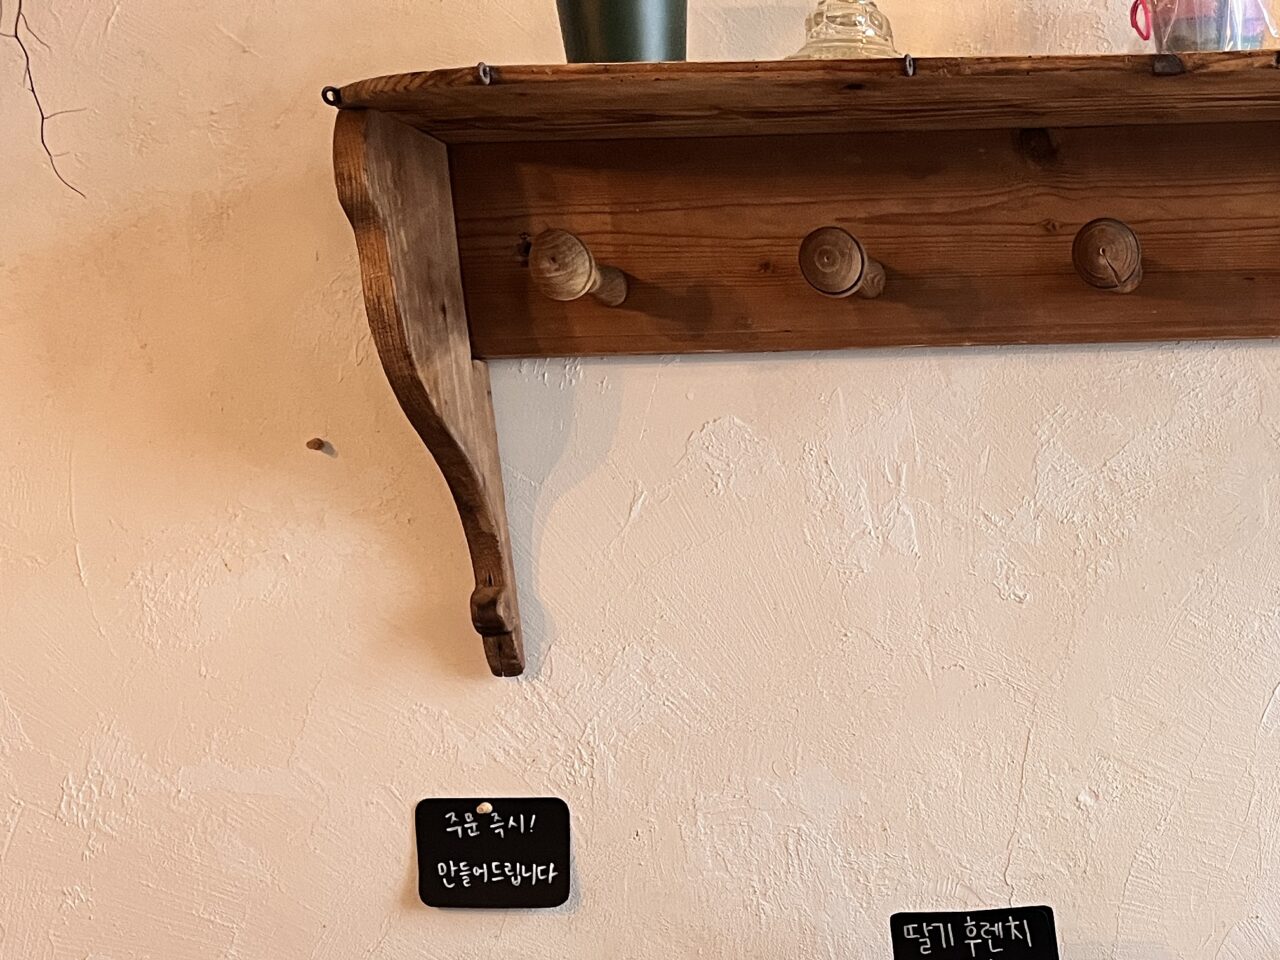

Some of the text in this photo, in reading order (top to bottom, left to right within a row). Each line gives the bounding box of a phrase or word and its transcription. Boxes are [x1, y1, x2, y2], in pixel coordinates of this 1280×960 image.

[445, 812, 536, 838] 주문 즉시!
[437, 860, 558, 888] 만들어드립니다
[904, 916, 1032, 957] 딸기 후렌치
